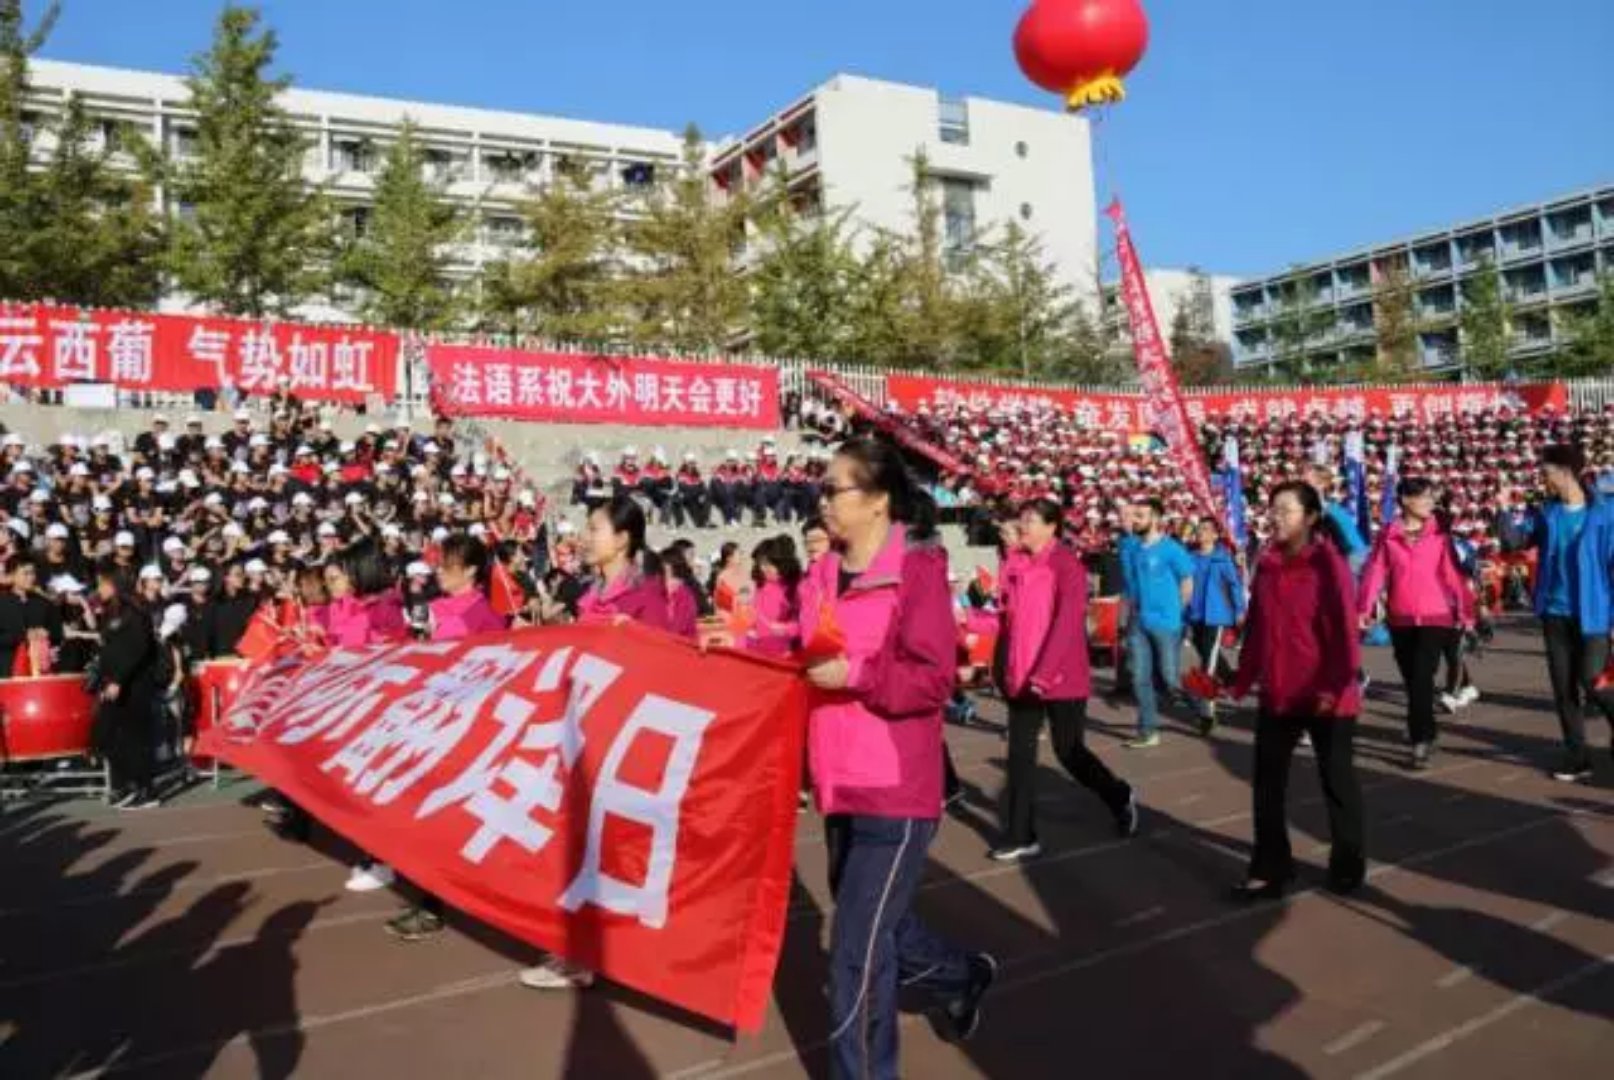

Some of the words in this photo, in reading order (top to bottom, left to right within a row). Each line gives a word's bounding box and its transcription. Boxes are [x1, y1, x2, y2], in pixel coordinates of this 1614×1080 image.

[187, 325, 374, 392] 气势如虹
[451, 360, 762, 418] 法语系祝大外明天会更好
